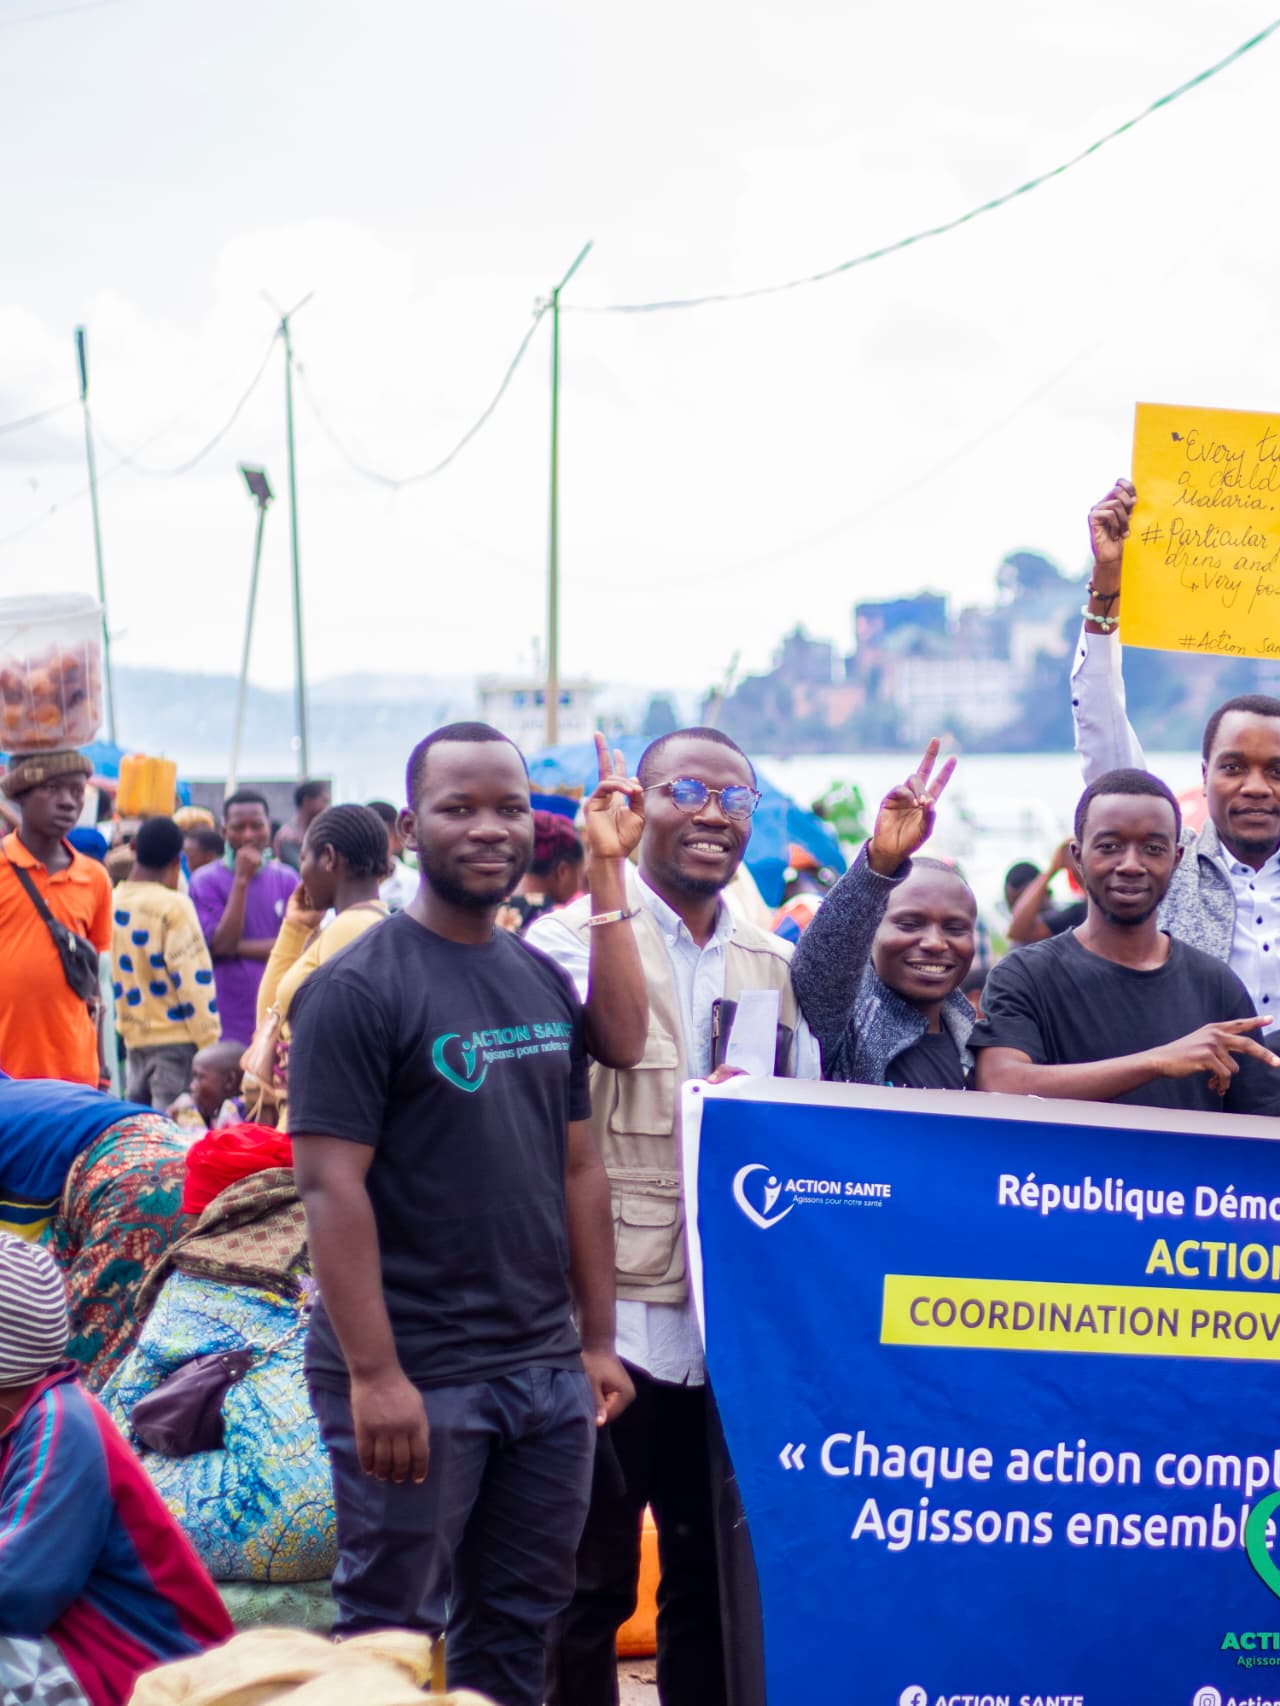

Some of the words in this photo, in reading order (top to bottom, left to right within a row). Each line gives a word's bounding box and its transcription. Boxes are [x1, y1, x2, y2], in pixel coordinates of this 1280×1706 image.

[1178, 471, 1194, 486] a
[1233, 552, 1276, 573] and
[1178, 630, 1246, 656] #Action
[473, 1025, 531, 1048] ACTION
[516, 1044, 540, 1060] pour
[784, 1178, 842, 1195] ACTION
[845, 1182, 892, 1198] SANTE
[999, 1172, 1185, 1221] République
[793, 1194, 824, 1206] Agissons
[825, 1197, 842, 1206] pour
[844, 1198, 863, 1207] notre
[864, 1199, 883, 1208] santé
[909, 1295, 1180, 1338] COORDINATION
[820, 1430, 993, 1488] Chaque
[1006, 1438, 1141, 1484] action
[850, 1496, 1053, 1551] Agissons
